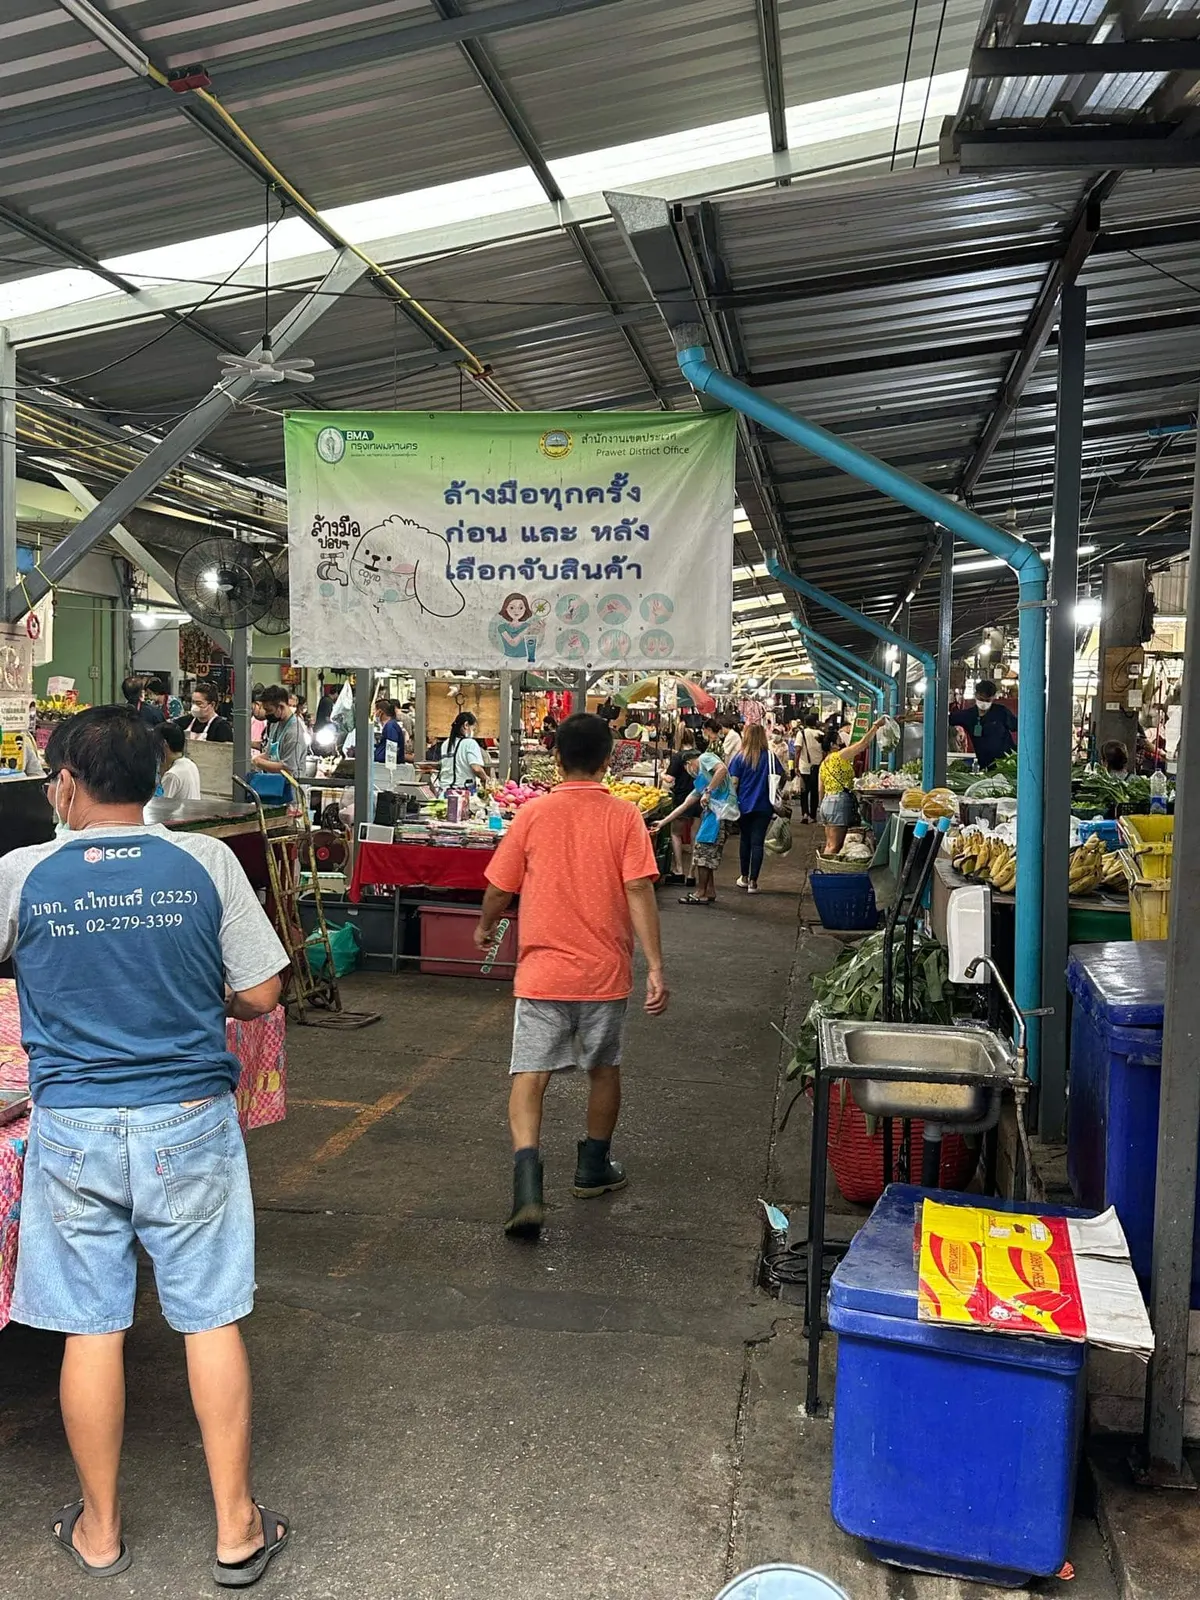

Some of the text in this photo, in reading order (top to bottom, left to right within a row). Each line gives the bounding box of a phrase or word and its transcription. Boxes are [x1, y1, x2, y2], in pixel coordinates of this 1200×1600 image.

[346, 432, 370, 440] BMA
[581, 431, 678, 444] สำนักงานเขตประเวศ
[350, 443, 418, 453] กรุงเทพมหานคร
[596, 445, 690, 457] Prawet District Office
[443, 472, 641, 511] ล้างมือทุกครั้ง
[311, 514, 361, 537] ล้างมือ
[445, 517, 650, 543] ก่อน และ หลัง
[358, 568, 381, 582] COVID
[445, 555, 642, 580] เลือกจับสินค้า
[105, 847, 141, 860] SCG
[31, 887, 198, 916] บจก. ส.ไทยเสรี (2525)
[48, 913, 183, 937] โทร. 02-279-3399
